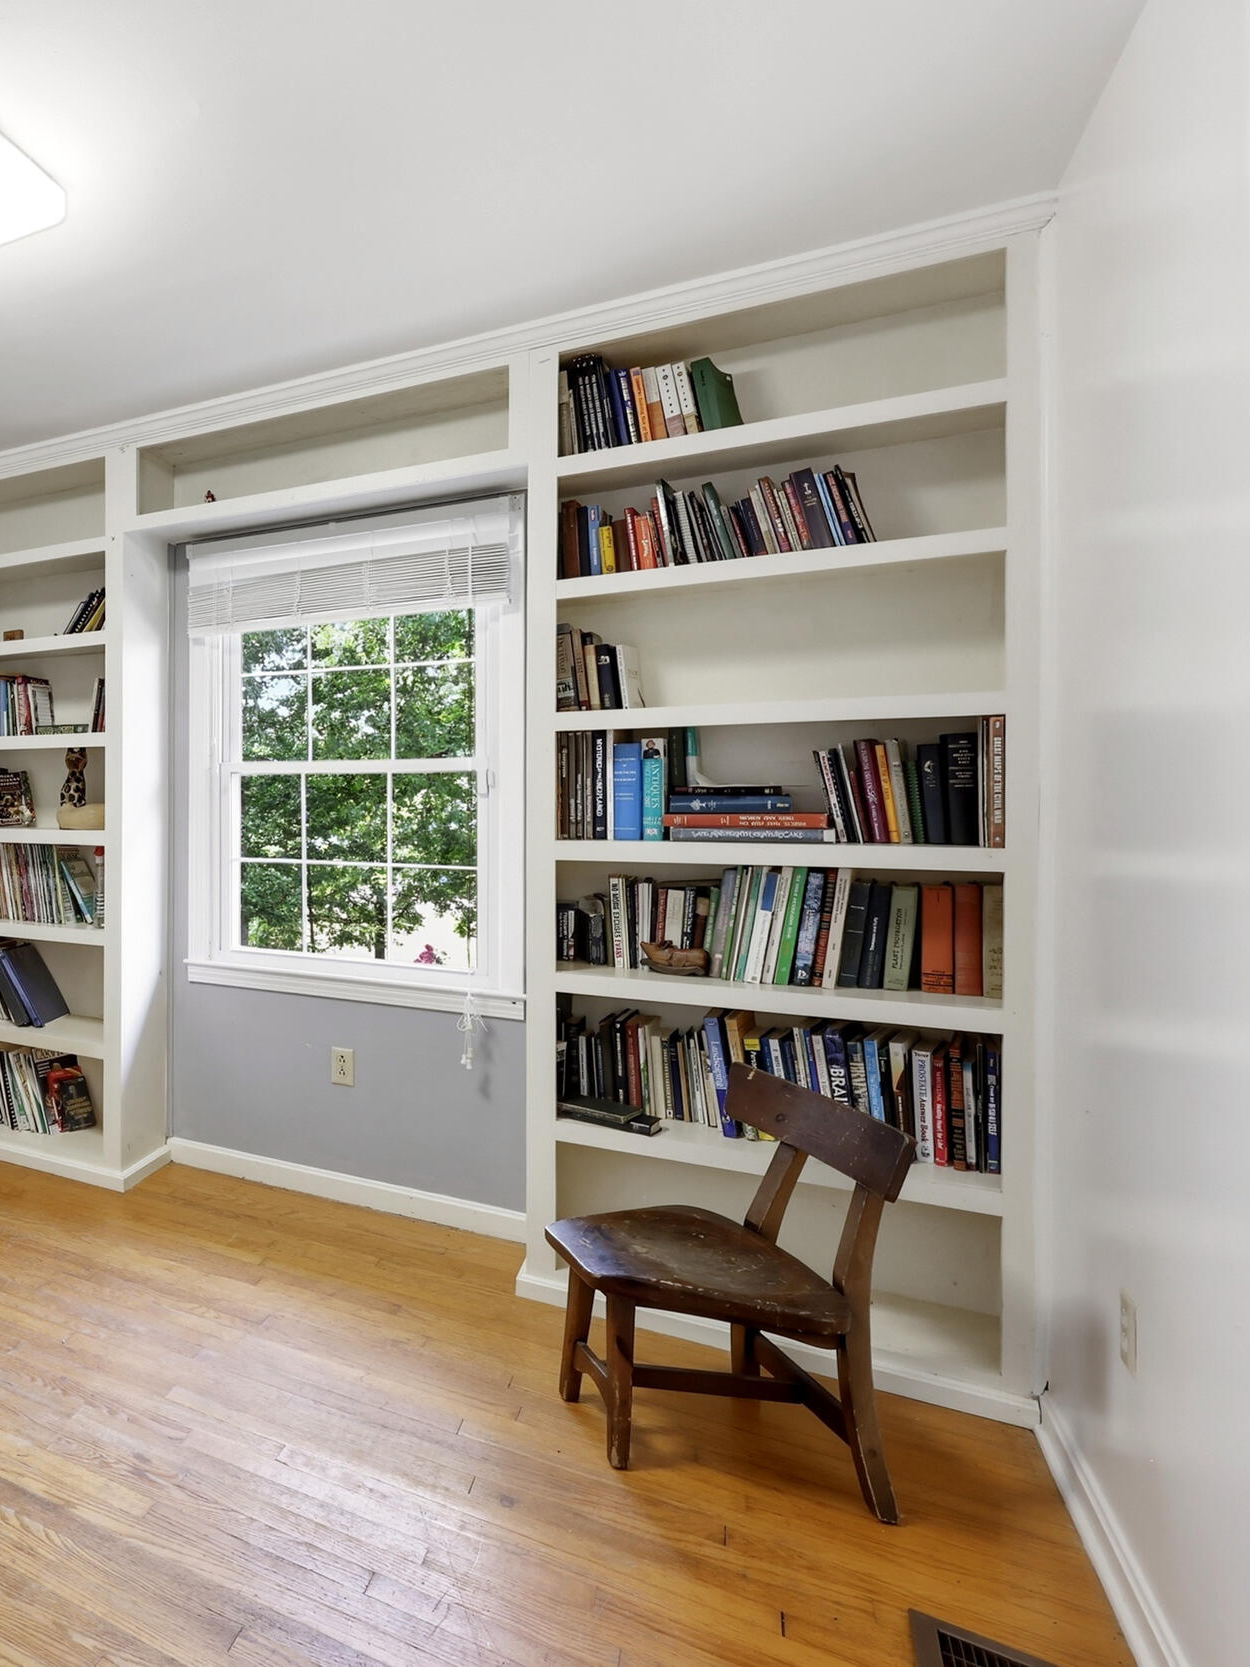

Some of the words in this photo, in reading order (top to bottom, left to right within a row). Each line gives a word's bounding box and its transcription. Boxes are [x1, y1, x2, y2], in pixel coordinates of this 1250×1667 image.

[993, 755, 1001, 772] MAPS
[649, 760, 660, 809] ANTIQUES
[610, 883, 617, 891] NO
[611, 892, 619, 910] MORE
[611, 911, 621, 938] EXCUSES
[613, 938, 622, 959] EVANS
[891, 949, 900, 969] PLANT
[709, 1040, 725, 1090] Landscaping
[916, 1057, 931, 1097] PROSTATE
[917, 1096, 930, 1124] Answer
[918, 1123, 932, 1143] Book
